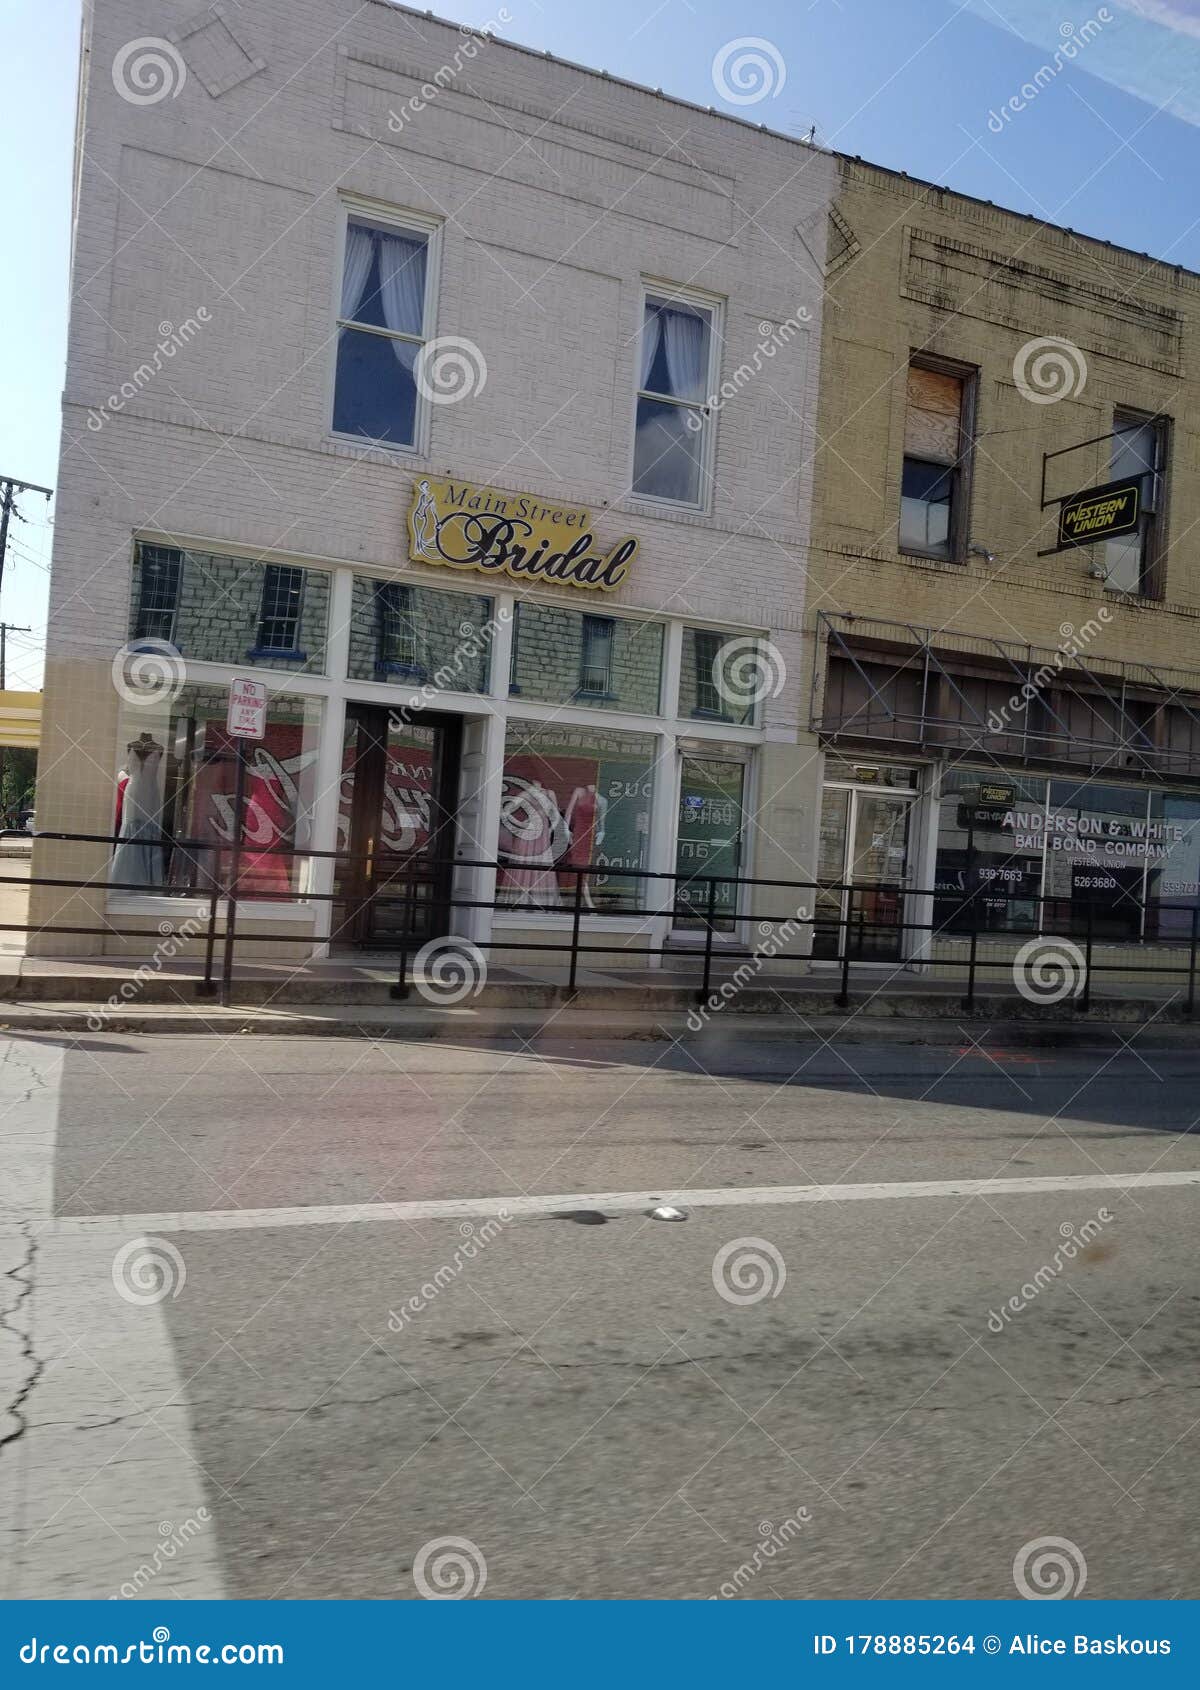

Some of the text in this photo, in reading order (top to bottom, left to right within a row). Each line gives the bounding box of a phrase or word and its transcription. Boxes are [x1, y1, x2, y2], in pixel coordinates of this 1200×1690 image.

[443, 485, 588, 529] Main Street
[1065, 496, 1128, 525] WESTERN
[1073, 512, 1116, 534] UNION
[436, 511, 637, 587] Bridal
[242, 683, 256, 696] NO
[1002, 812, 1102, 834] ANDERSON
[1108, 820, 1122, 836] &
[1130, 823, 1184, 842] WHITE
[1015, 834, 1173, 860] BAIL BOND COMPANY
[1066, 855, 1127, 869] WESTERN UNION
[979, 868, 1023, 882] 939-7663
[1074, 876, 1116, 889] 526-3680
